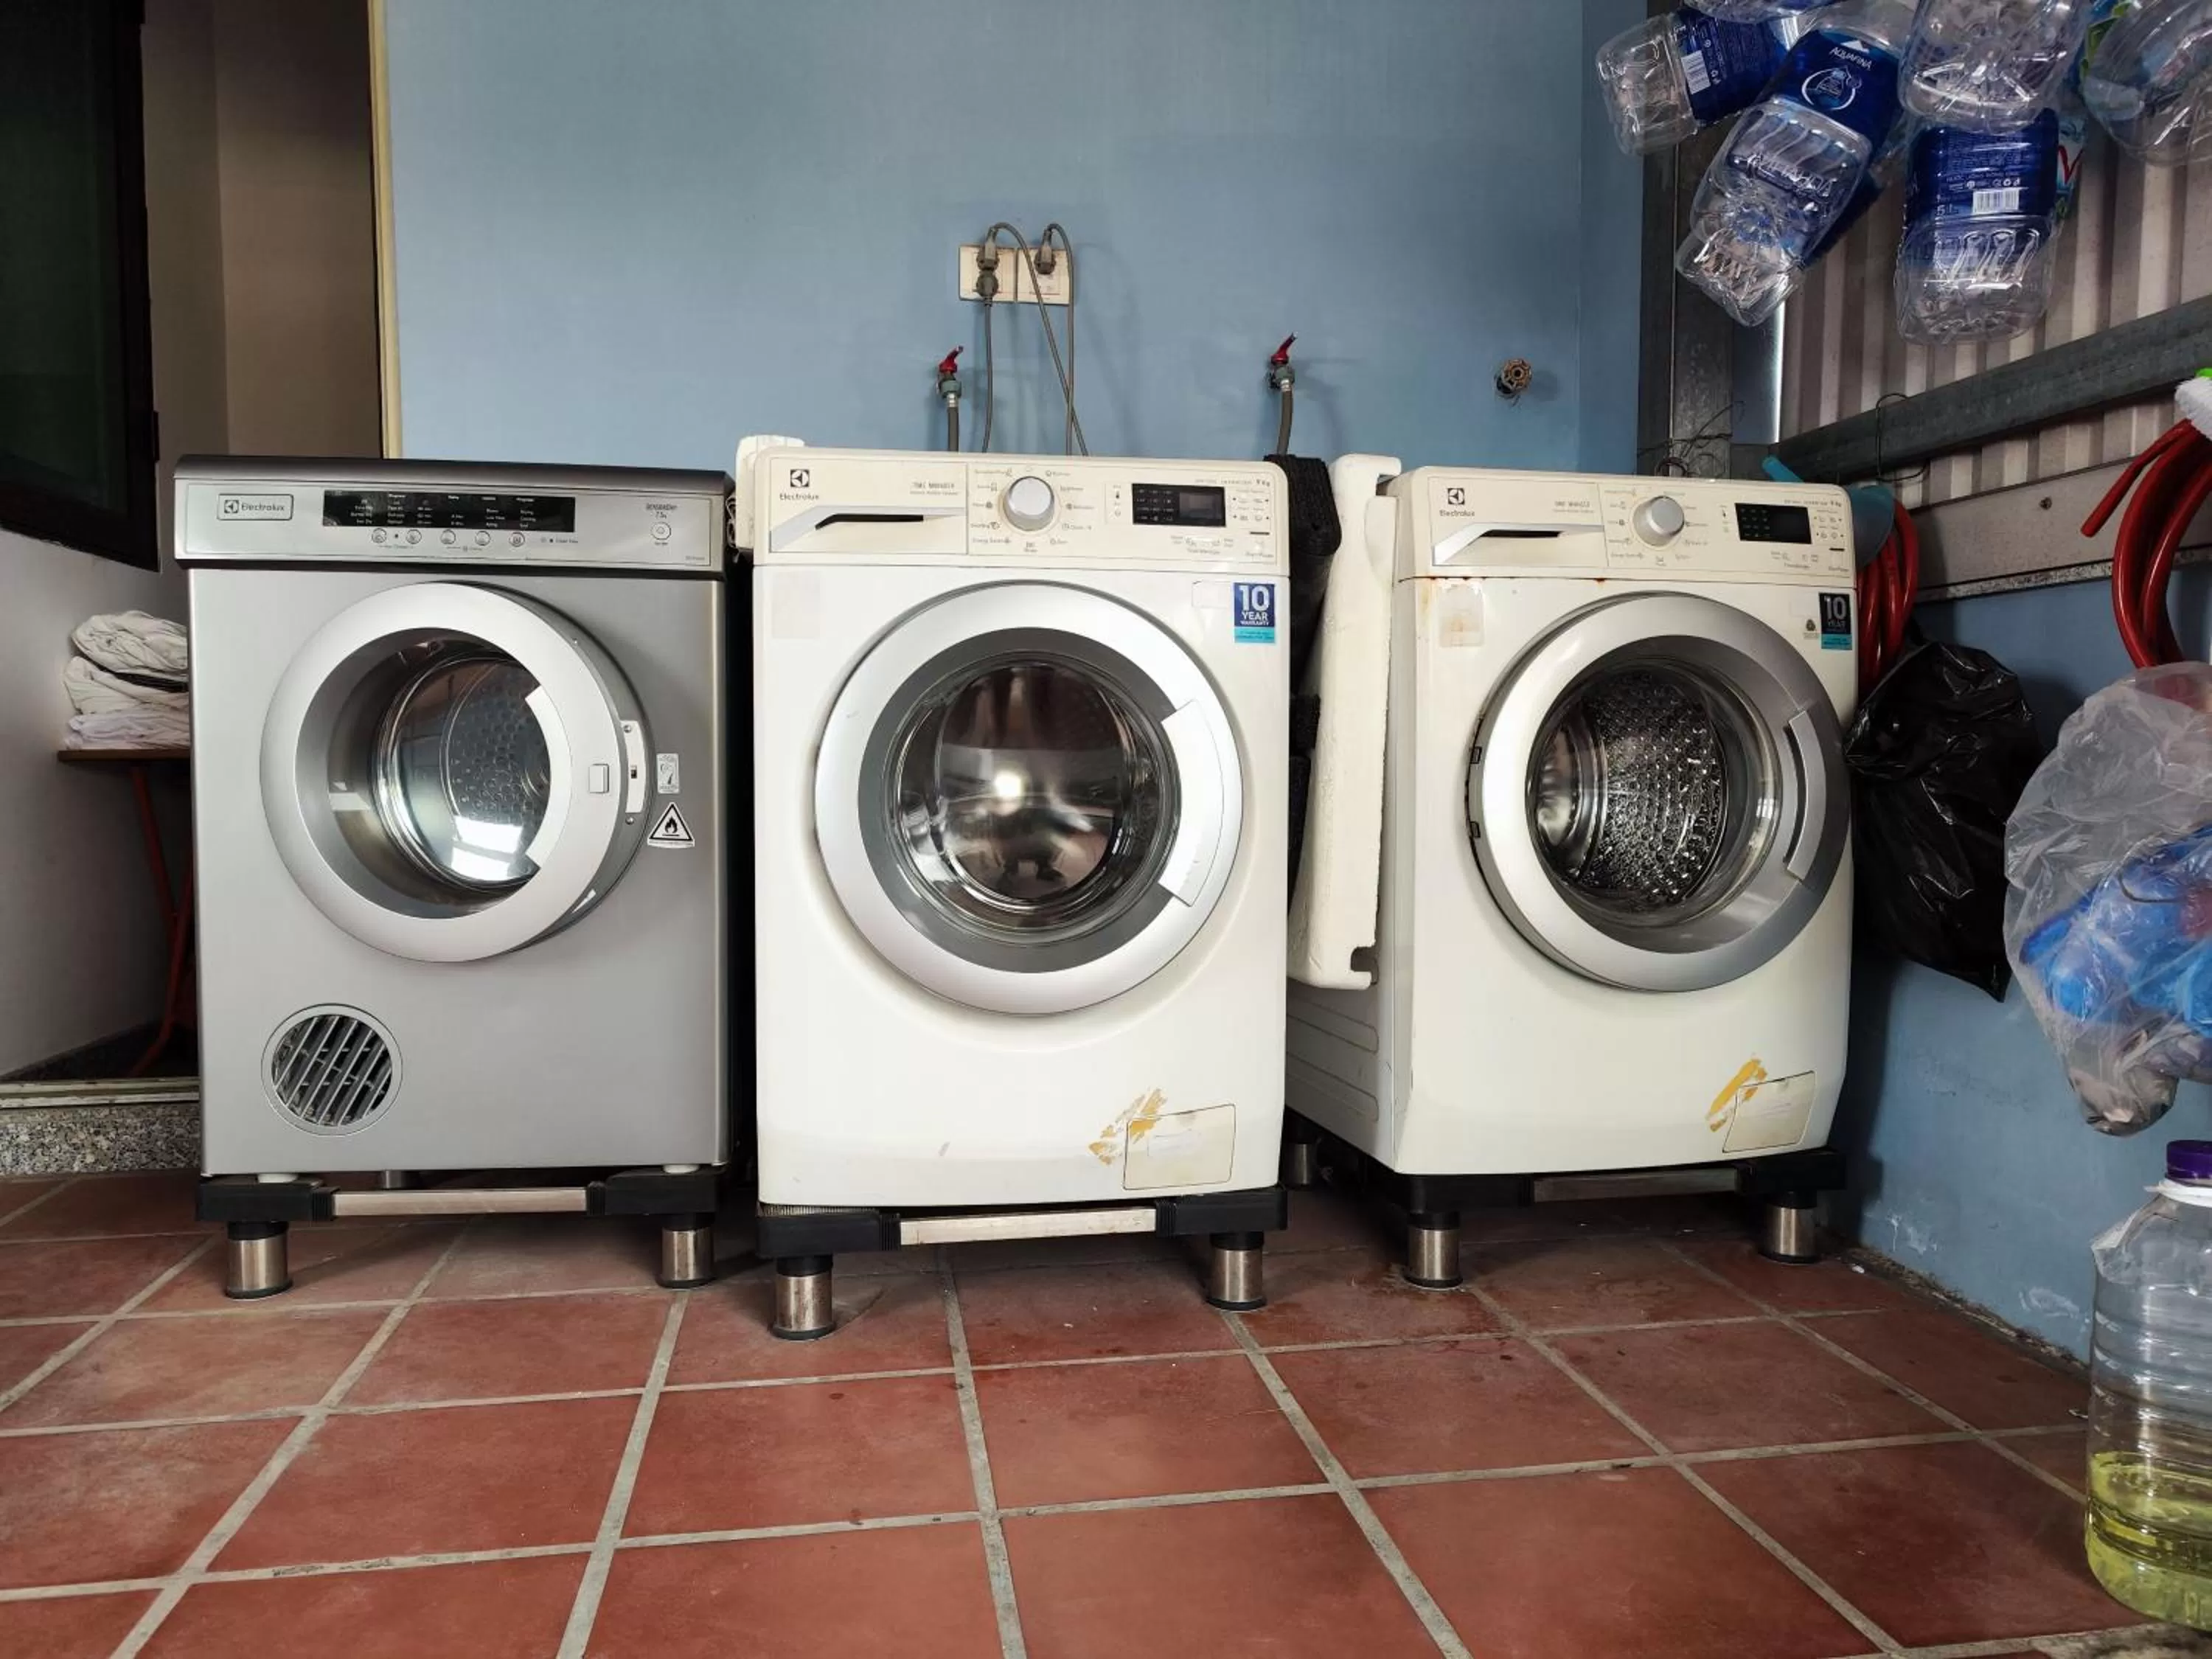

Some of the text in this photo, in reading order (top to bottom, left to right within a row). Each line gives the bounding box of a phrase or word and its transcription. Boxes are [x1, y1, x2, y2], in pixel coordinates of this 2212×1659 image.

[1829, 47, 1873, 72] AQUAFINA
[779, 493, 819, 501] Electrolux
[241, 502, 285, 511] Electrolux
[1439, 509, 1475, 518] Electrolux
[1239, 585, 1270, 611] 10
[1823, 595, 1846, 620] 10
[1242, 611, 1268, 621] YEAR
